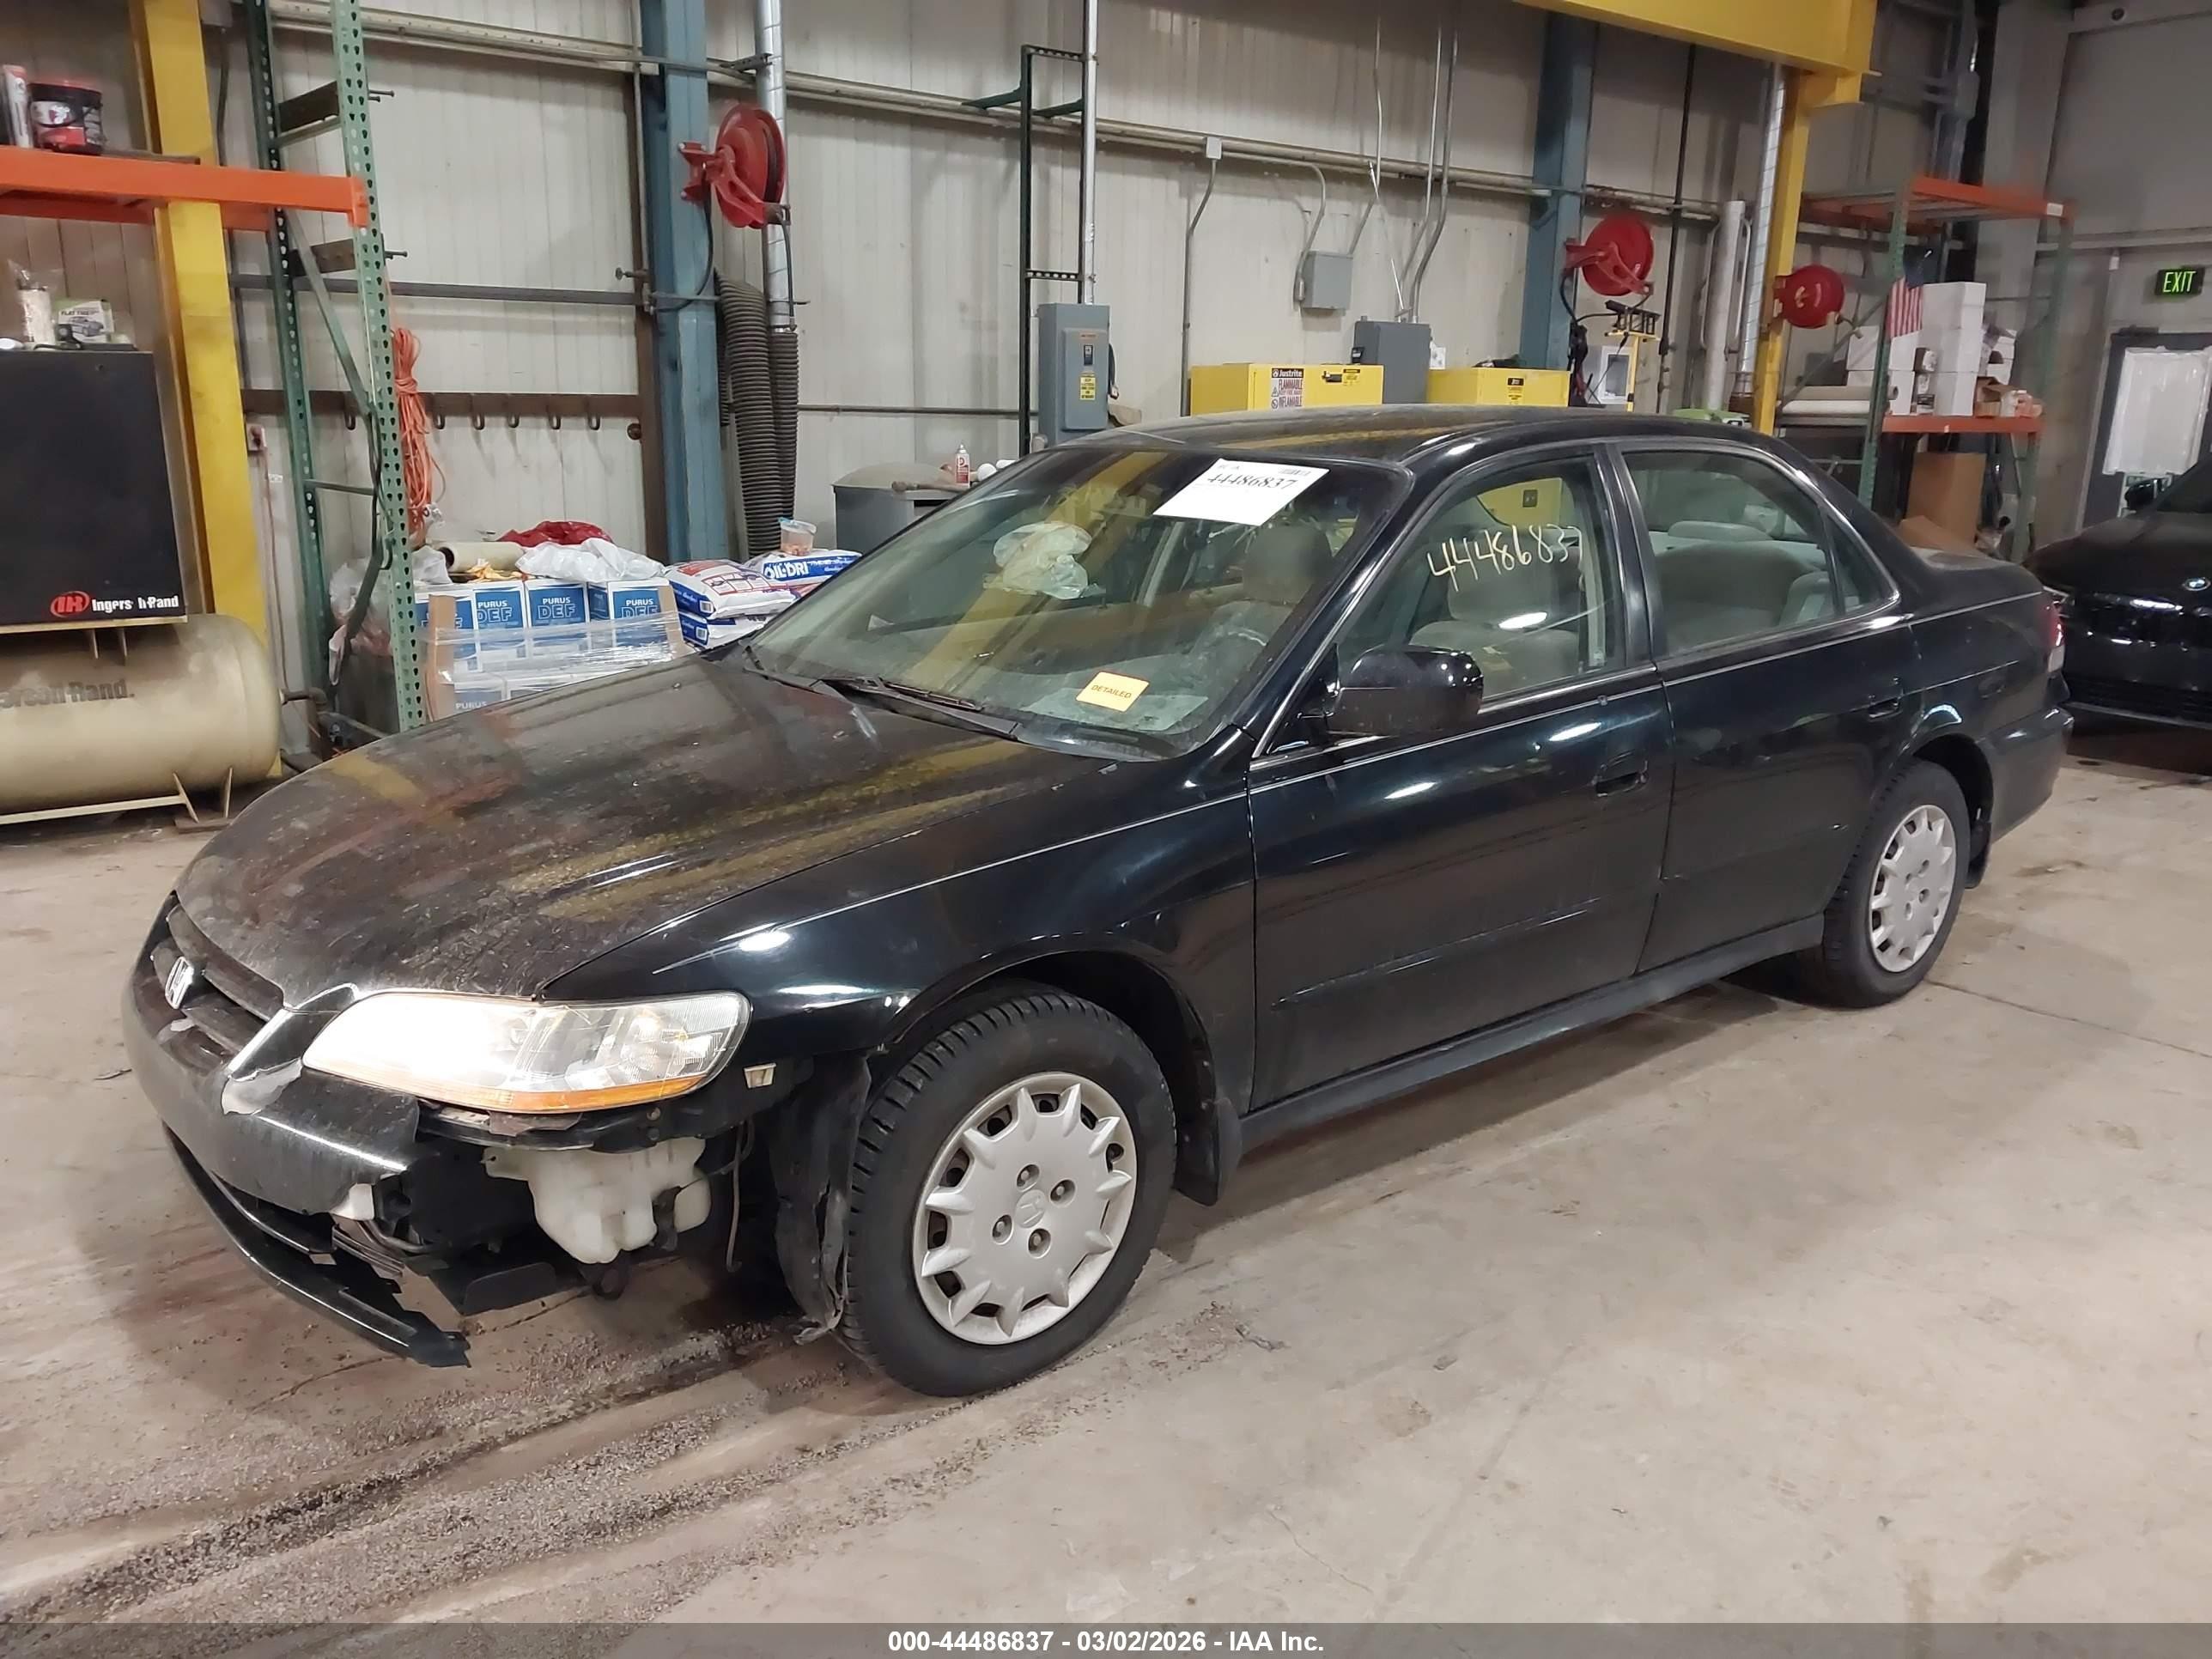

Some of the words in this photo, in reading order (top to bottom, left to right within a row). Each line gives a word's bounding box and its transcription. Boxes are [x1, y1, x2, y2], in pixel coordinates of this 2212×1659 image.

[2163, 270, 2197, 292] EXIT
[1279, 369, 1303, 378] Justrite
[1207, 473, 1298, 489] 44486837
[477, 599, 508, 609] PURUS
[625, 598, 654, 606] PURUS
[477, 607, 513, 623] DEF
[538, 604, 576, 619] DEF
[1091, 684, 1133, 699] DETAILED
